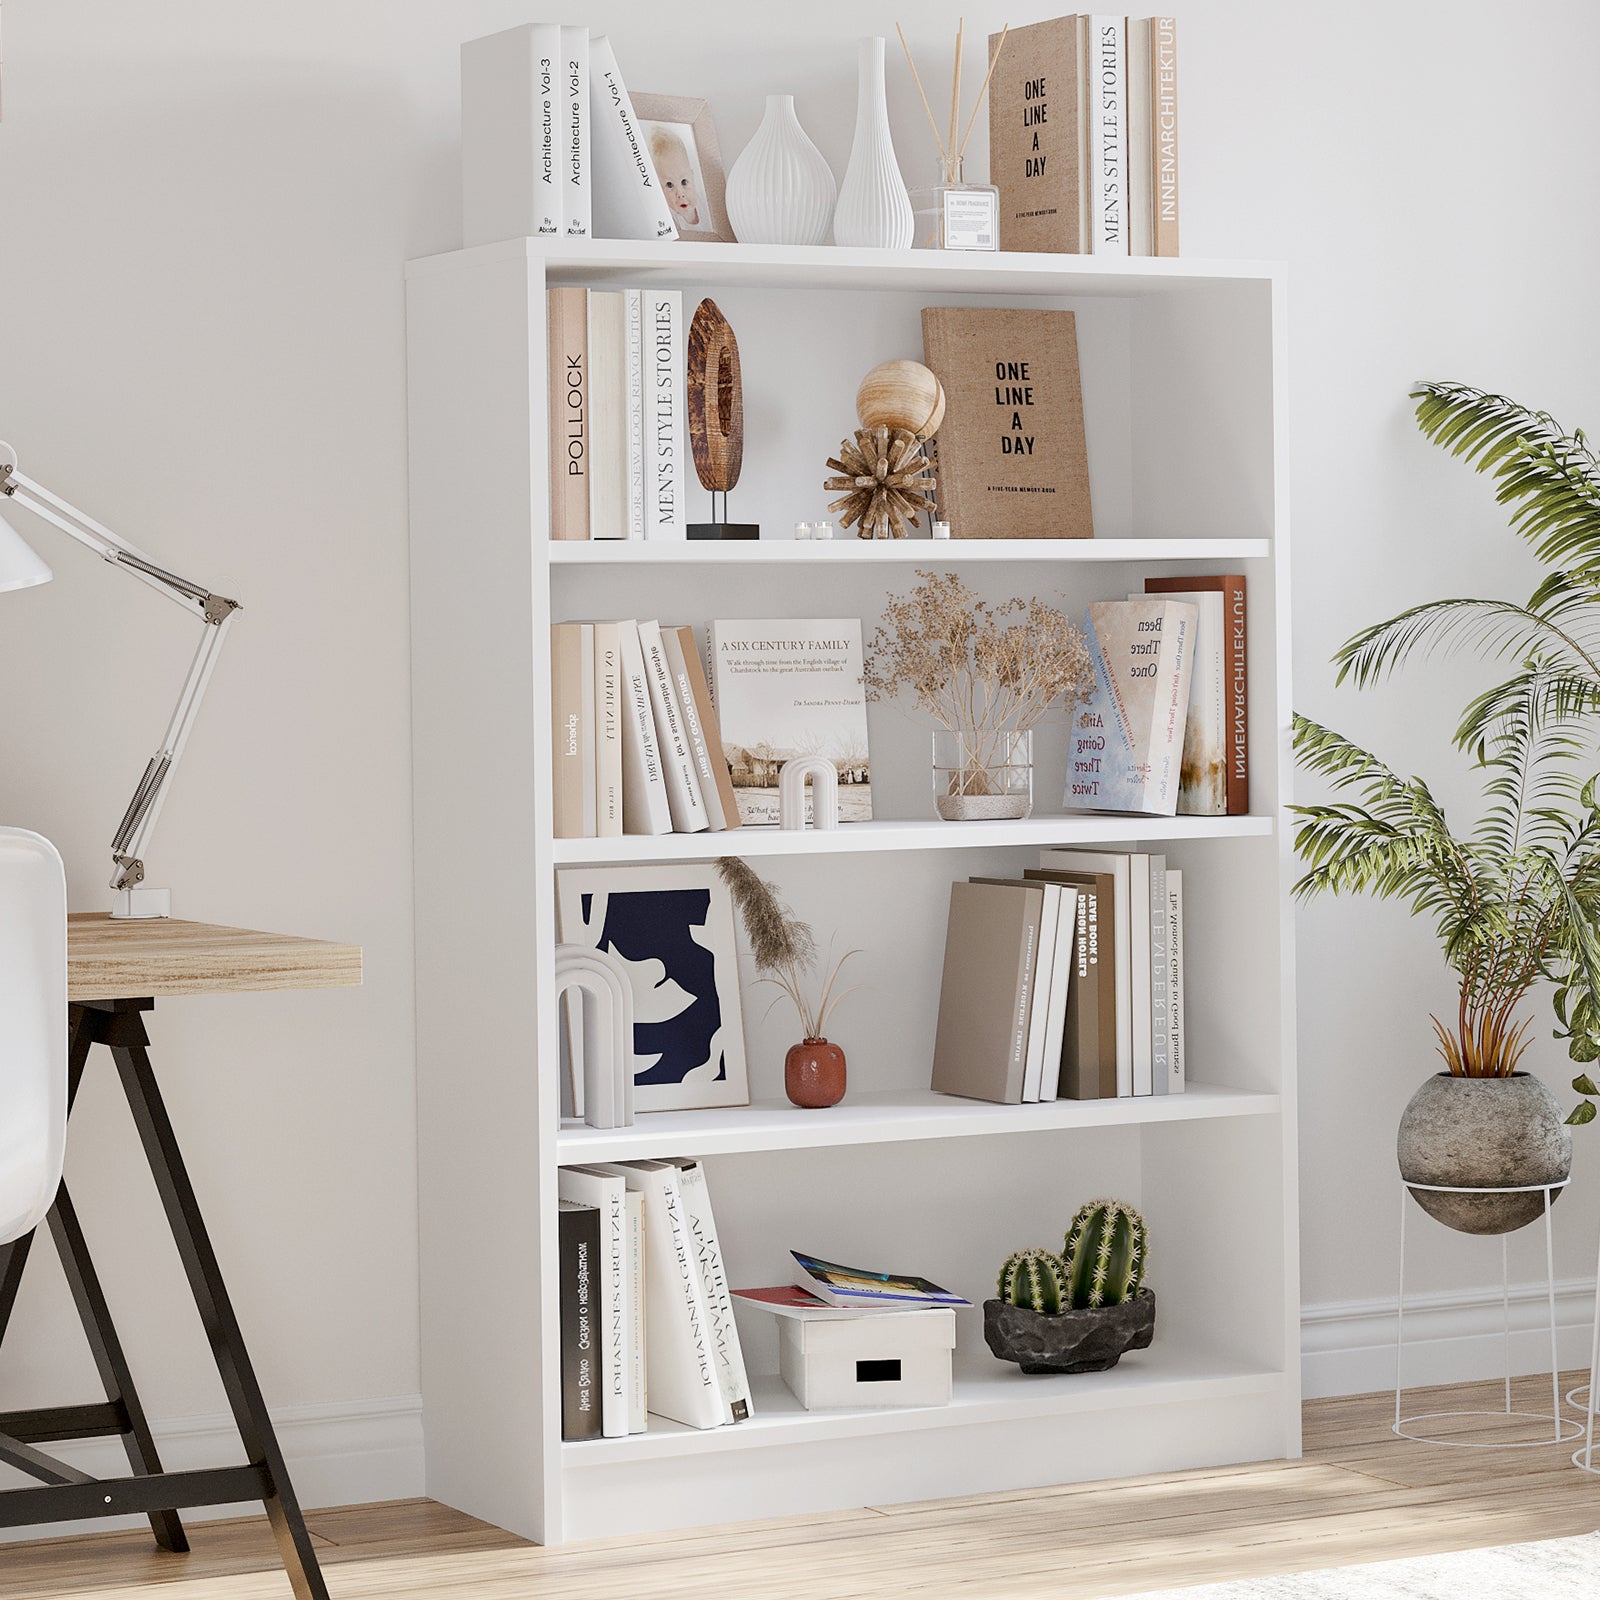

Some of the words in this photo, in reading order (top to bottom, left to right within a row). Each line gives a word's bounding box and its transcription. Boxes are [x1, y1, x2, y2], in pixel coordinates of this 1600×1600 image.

[541, 58, 551, 94] Vol-3
[569, 61, 579, 97] Vol-2
[1102, 26, 1117, 110] STORIES
[604, 72, 621, 106] Vol-1
[1025, 78, 1046, 100] ONE
[1023, 104, 1048, 127] LINE
[1159, 18, 1176, 221] INNENARCHITEKTUR
[542, 100, 552, 184] Architecture
[571, 102, 580, 185] Architecture
[619, 110, 652, 187] Architecture
[1032, 131, 1039, 151] A
[1104, 116, 1118, 178] STYLE
[1025, 156, 1047, 178] DAY
[1105, 183, 1119, 243] MEN'S
[630, 296, 640, 398] REVOLUTION
[656, 301, 672, 388] STORIES
[995, 362, 1030, 381] ONE
[995, 387, 1035, 406] LINE
[567, 354, 584, 476] POLLOCK
[632, 404, 640, 445] LOOK
[657, 393, 673, 457] STYLE
[1011, 412, 1023, 431] A
[1001, 436, 1035, 455] DAY
[633, 447, 642, 486] NEW
[721, 642, 729, 651] A
[731, 641, 749, 651] SIX
[751, 640, 806, 651] CENTURY
[808, 640, 850, 650] FAMILY
[802, 658, 823, 666] English
[823, 658, 840, 666] village
[707, 653, 715, 703] CENTURY
[779, 666, 793, 674] great
[577, 1316, 590, 1350] Сказки
[612, 1292, 623, 1396] JOHANNES
[683, 1282, 713, 1387] JOHANNES
[578, 1359, 591, 1387] Бялко
[578, 1389, 591, 1411] Анна
